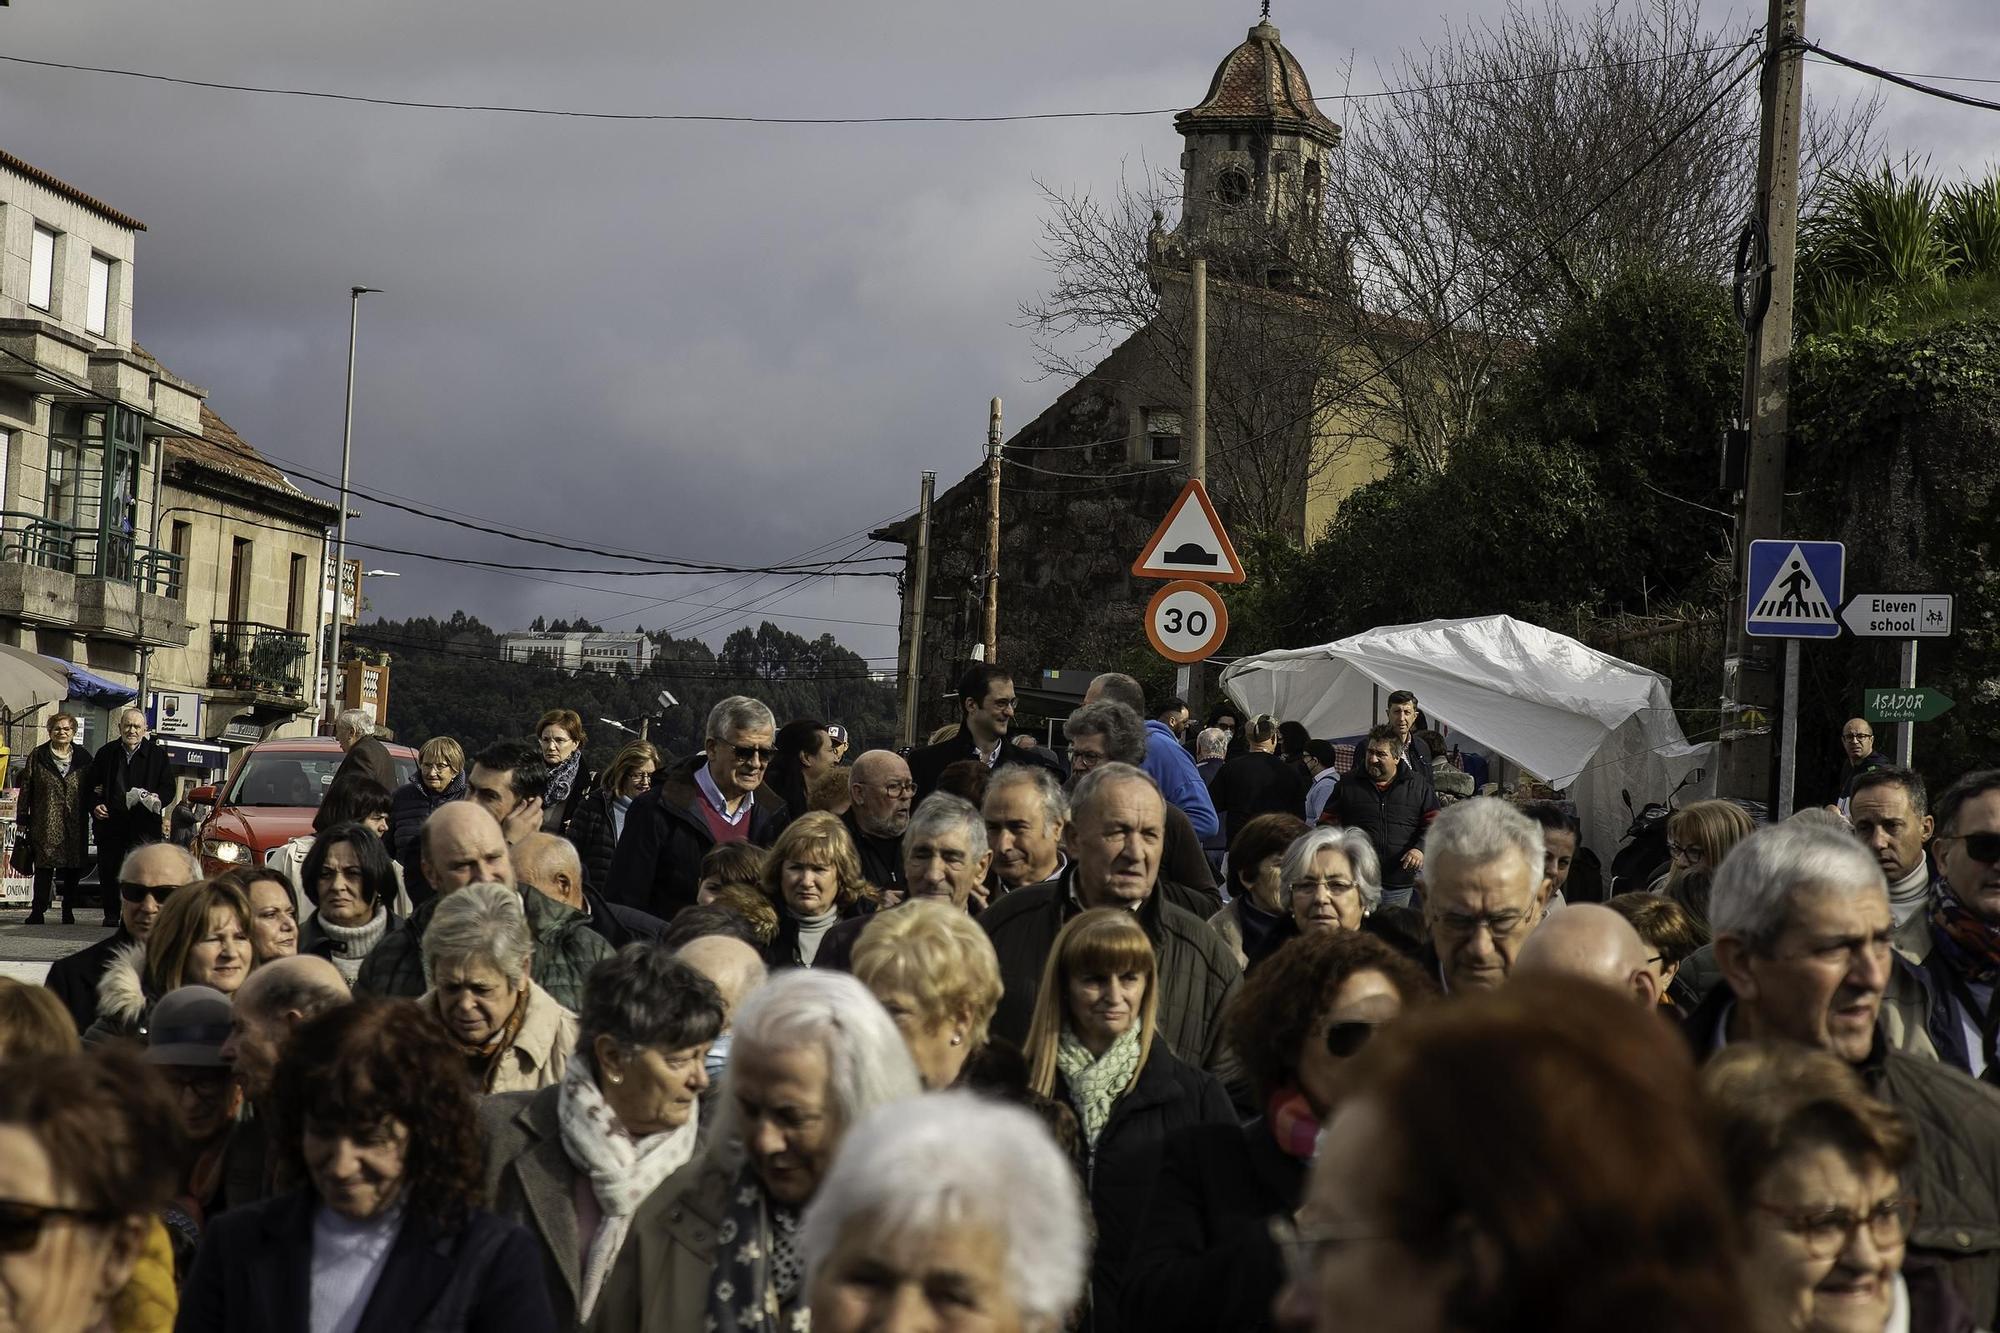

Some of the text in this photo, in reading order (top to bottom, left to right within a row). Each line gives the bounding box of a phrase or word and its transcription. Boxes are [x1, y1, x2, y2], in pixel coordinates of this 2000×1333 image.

[1872, 599, 1916, 613] Eleven
[1163, 608, 1208, 637] 30
[1870, 618, 1915, 631] school
[1871, 693, 1925, 710] ASADOR
